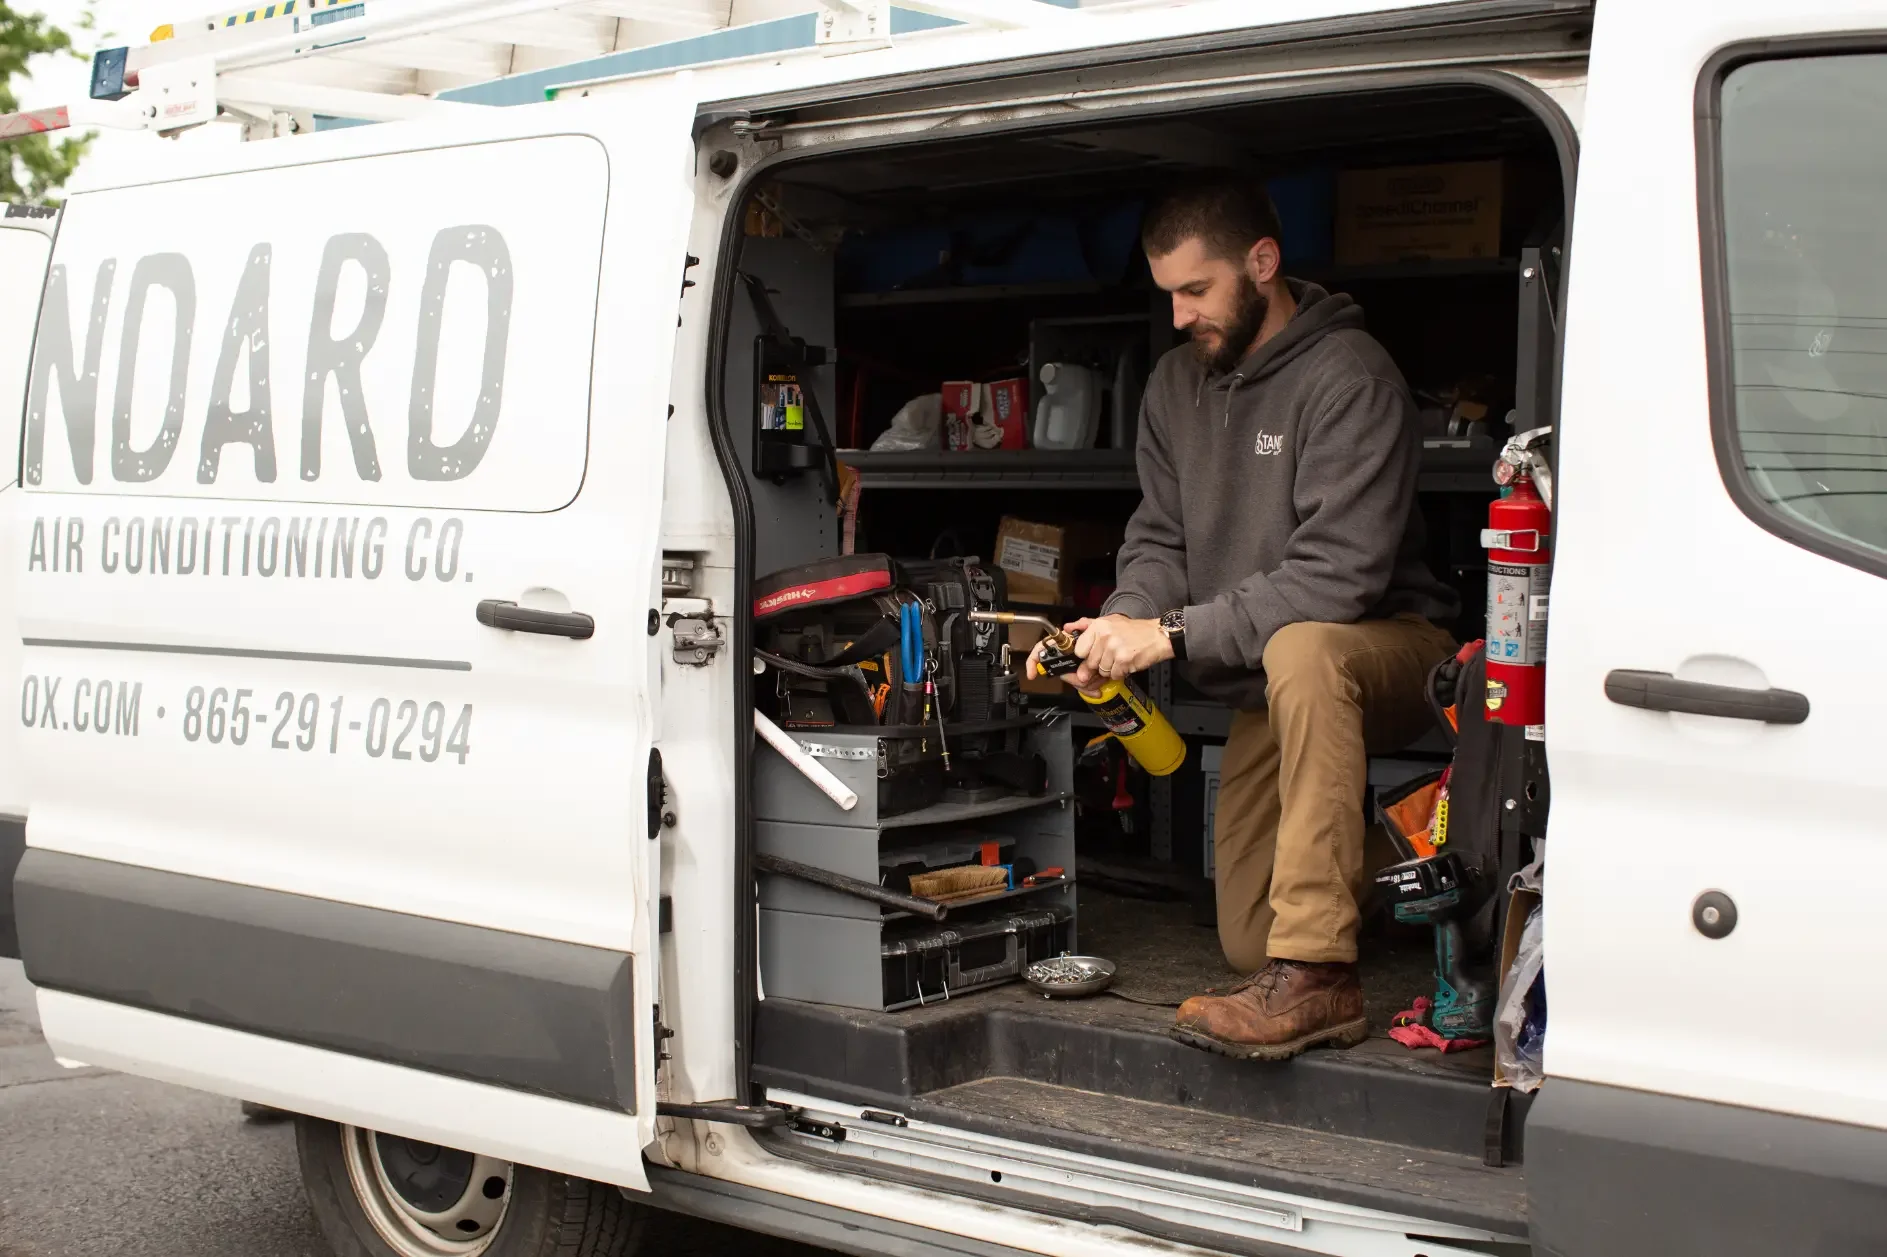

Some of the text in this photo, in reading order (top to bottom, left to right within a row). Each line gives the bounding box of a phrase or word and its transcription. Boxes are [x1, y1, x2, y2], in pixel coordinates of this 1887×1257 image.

[28, 516, 474, 583] AIR CONDITIONING CO.
[21, 675, 473, 766] OX.COM 865-291-0294
